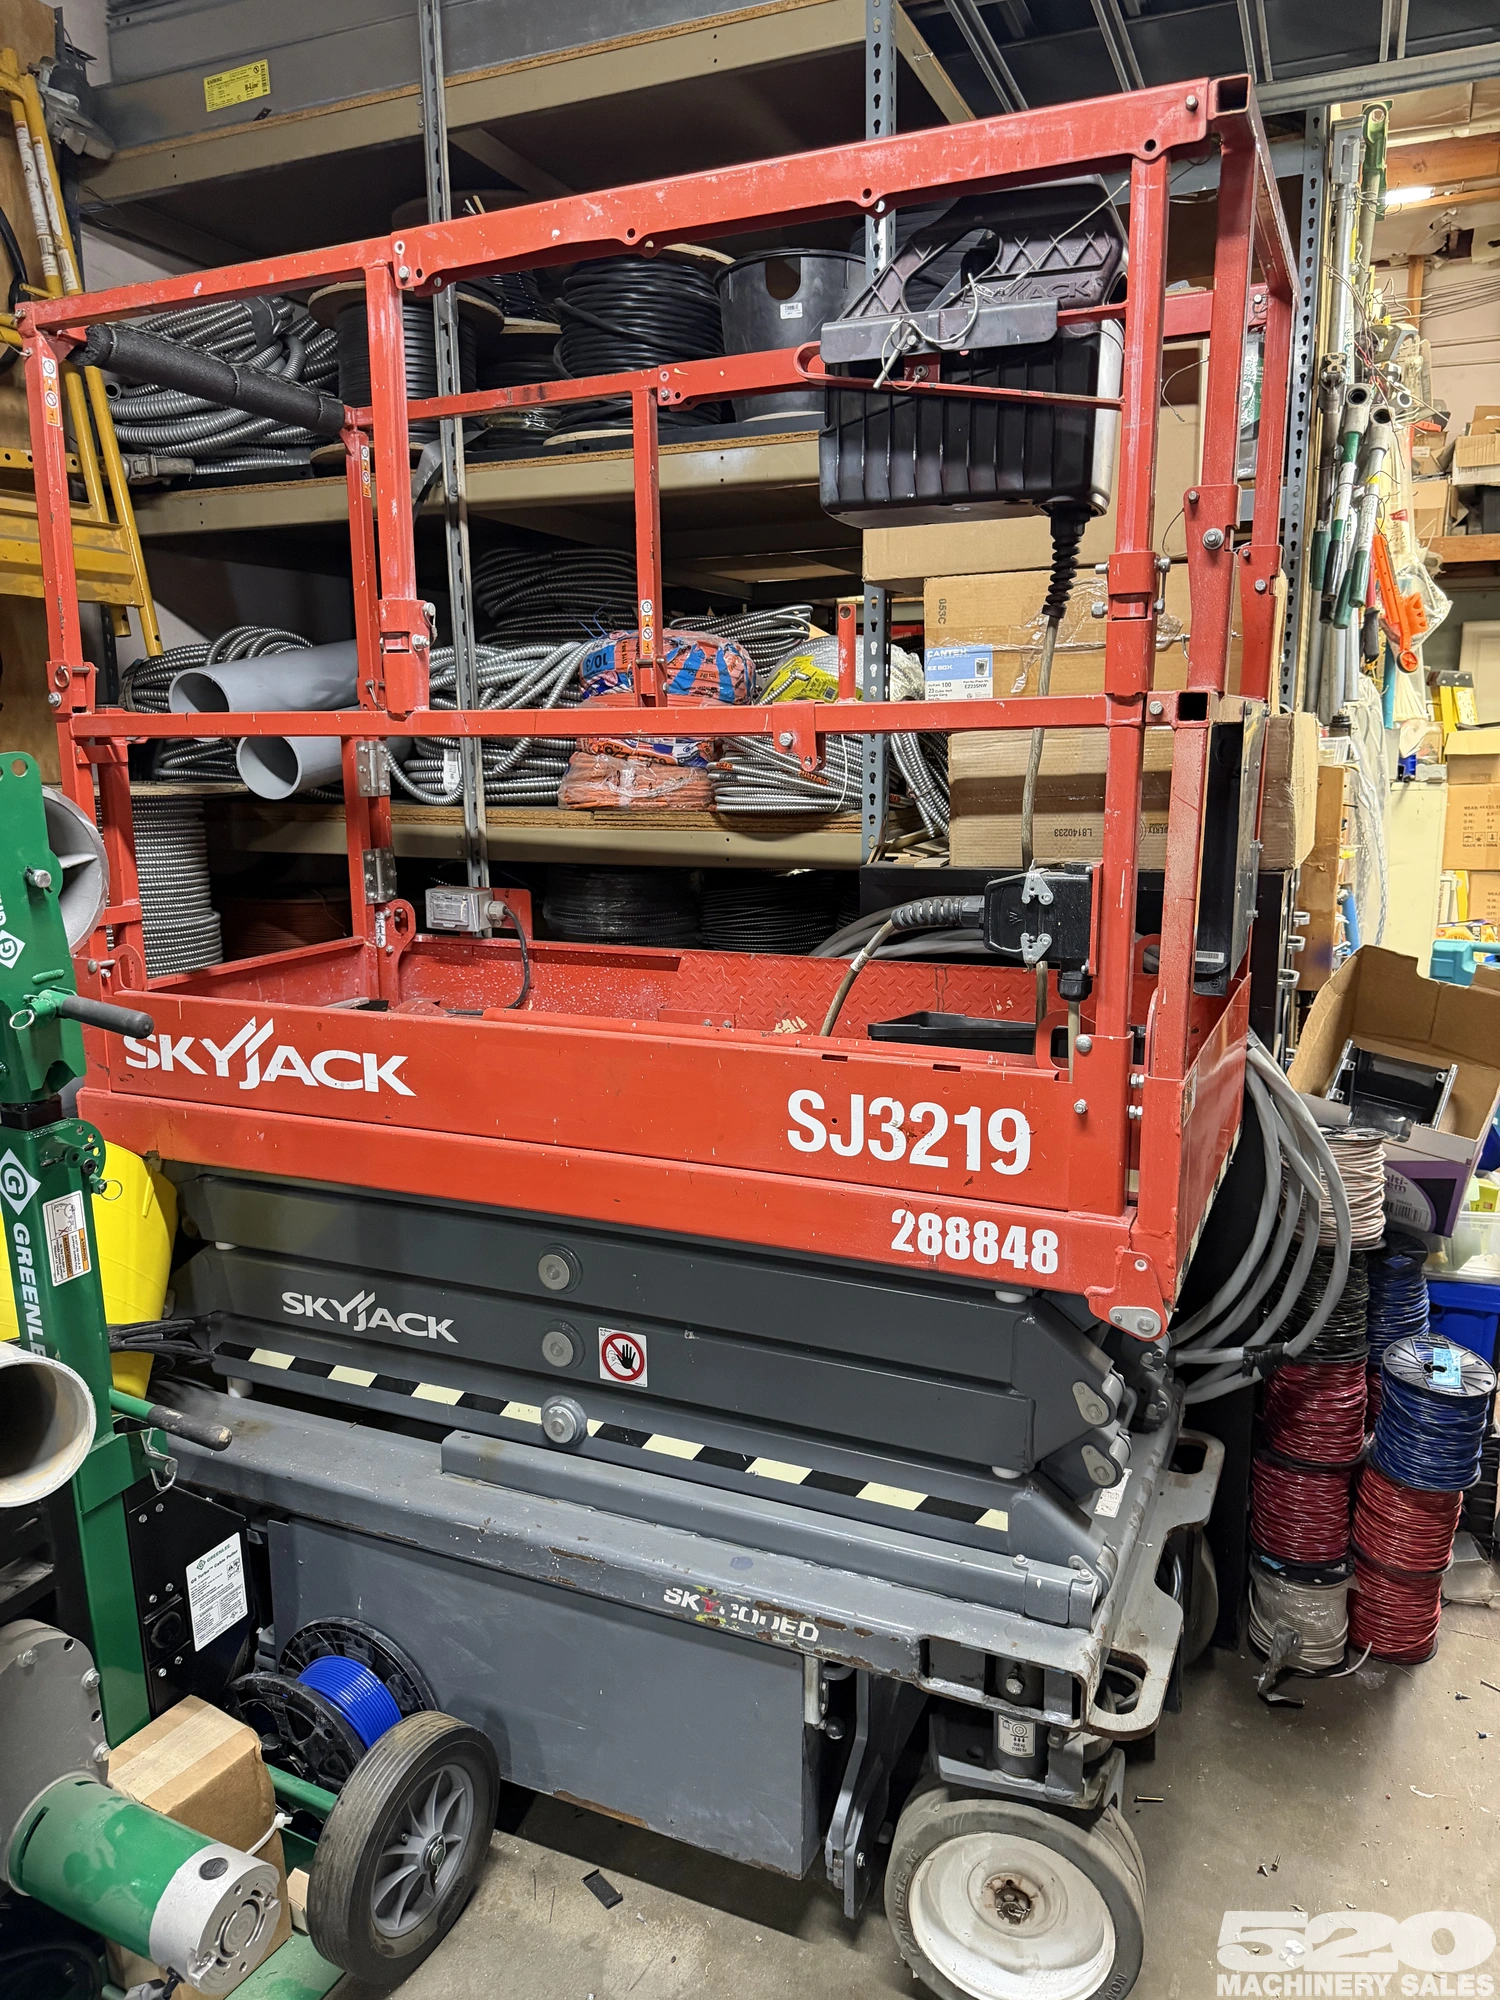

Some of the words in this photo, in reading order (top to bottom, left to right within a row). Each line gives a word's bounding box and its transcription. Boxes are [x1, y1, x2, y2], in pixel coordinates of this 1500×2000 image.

[938, 598, 947, 625] 053C
[926, 649, 968, 658] CANTEX
[1054, 828, 1092, 837] L8140233
[123, 1016, 417, 1097] SKYJACK
[787, 1089, 1031, 1175] SJ3219
[891, 1208, 1058, 1274] 288848
[282, 1290, 459, 1343] SKYJACK
[207, 1544, 231, 1562] GREENLEE
[226, 1549, 238, 1559] Puller
